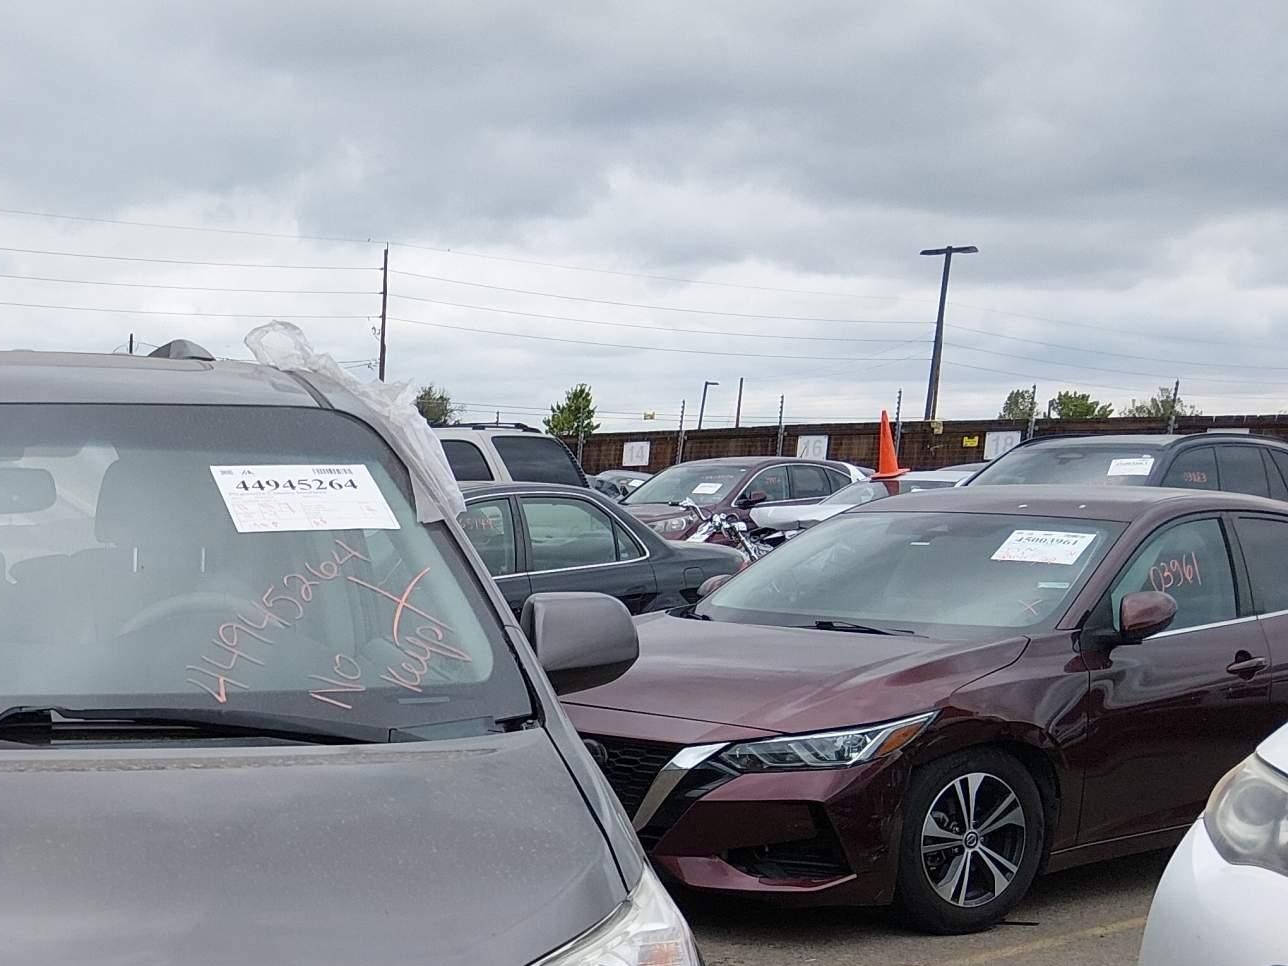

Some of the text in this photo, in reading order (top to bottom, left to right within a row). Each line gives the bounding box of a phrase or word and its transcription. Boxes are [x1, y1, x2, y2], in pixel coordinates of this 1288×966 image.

[629, 445, 645, 463] 14
[235, 478, 358, 492] 44945264
[1150, 551, 1202, 592] 03961
[186, 539, 372, 703] 44945264
